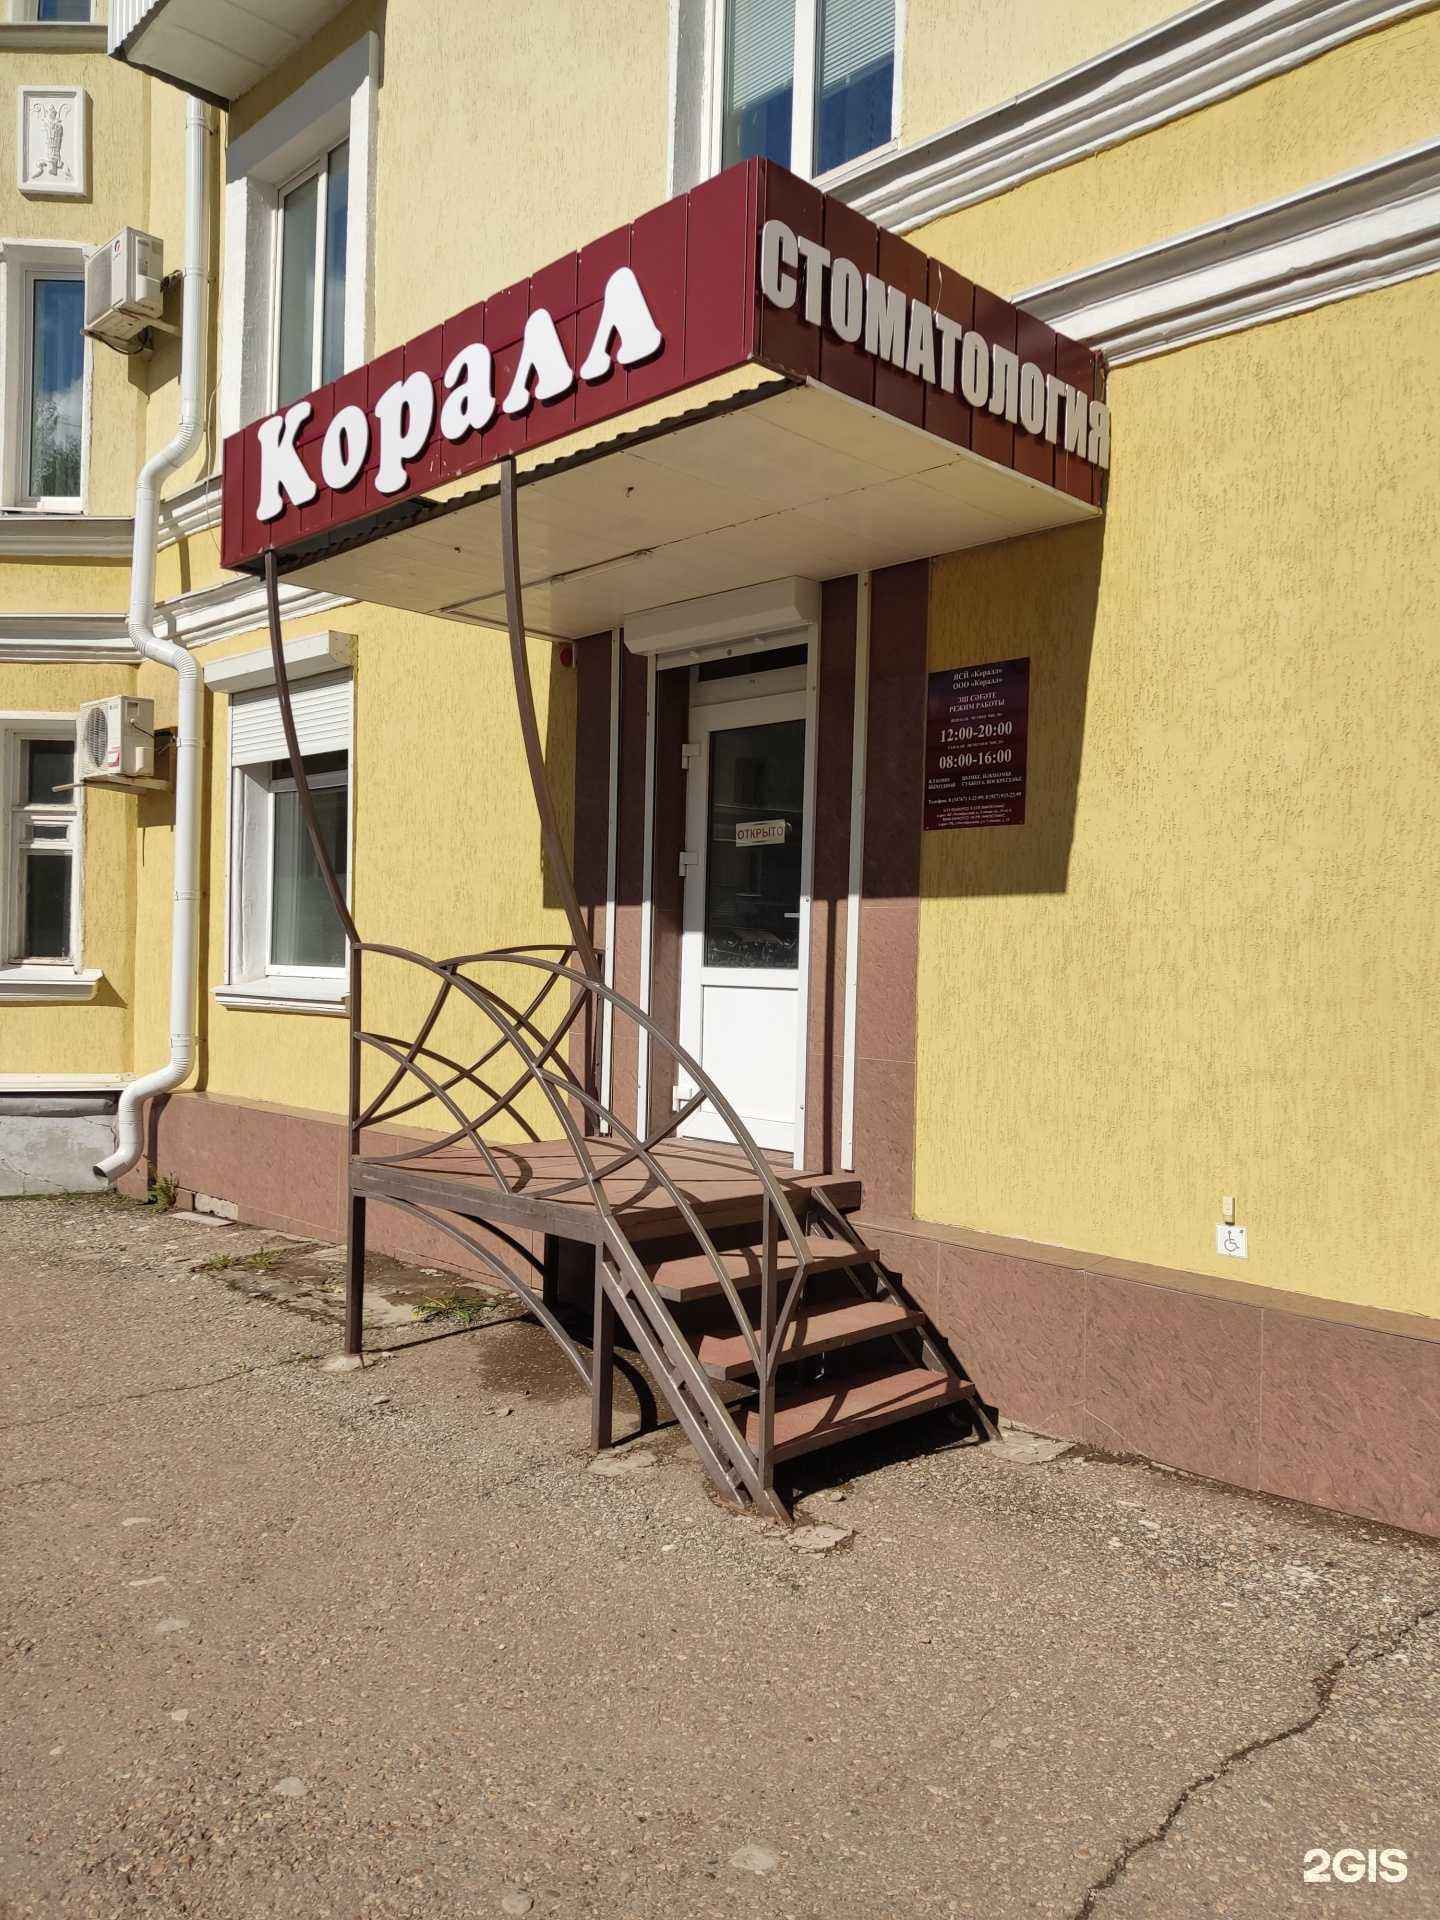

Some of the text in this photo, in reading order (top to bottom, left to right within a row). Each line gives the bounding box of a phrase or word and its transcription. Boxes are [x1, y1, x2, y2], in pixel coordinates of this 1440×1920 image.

[760, 219, 1111, 470] СТОМАТОЛОГИЯ
[256, 266, 663, 521] Коралл
[953, 681, 970, 690] ООО
[949, 698, 1005, 713] РЕЖИМ РАБОТЫ
[941, 721, 1013, 743] 12:00-20:00
[939, 748, 1012, 769] 08:00-16:00
[737, 826, 784, 840] ОТКРЫТО
